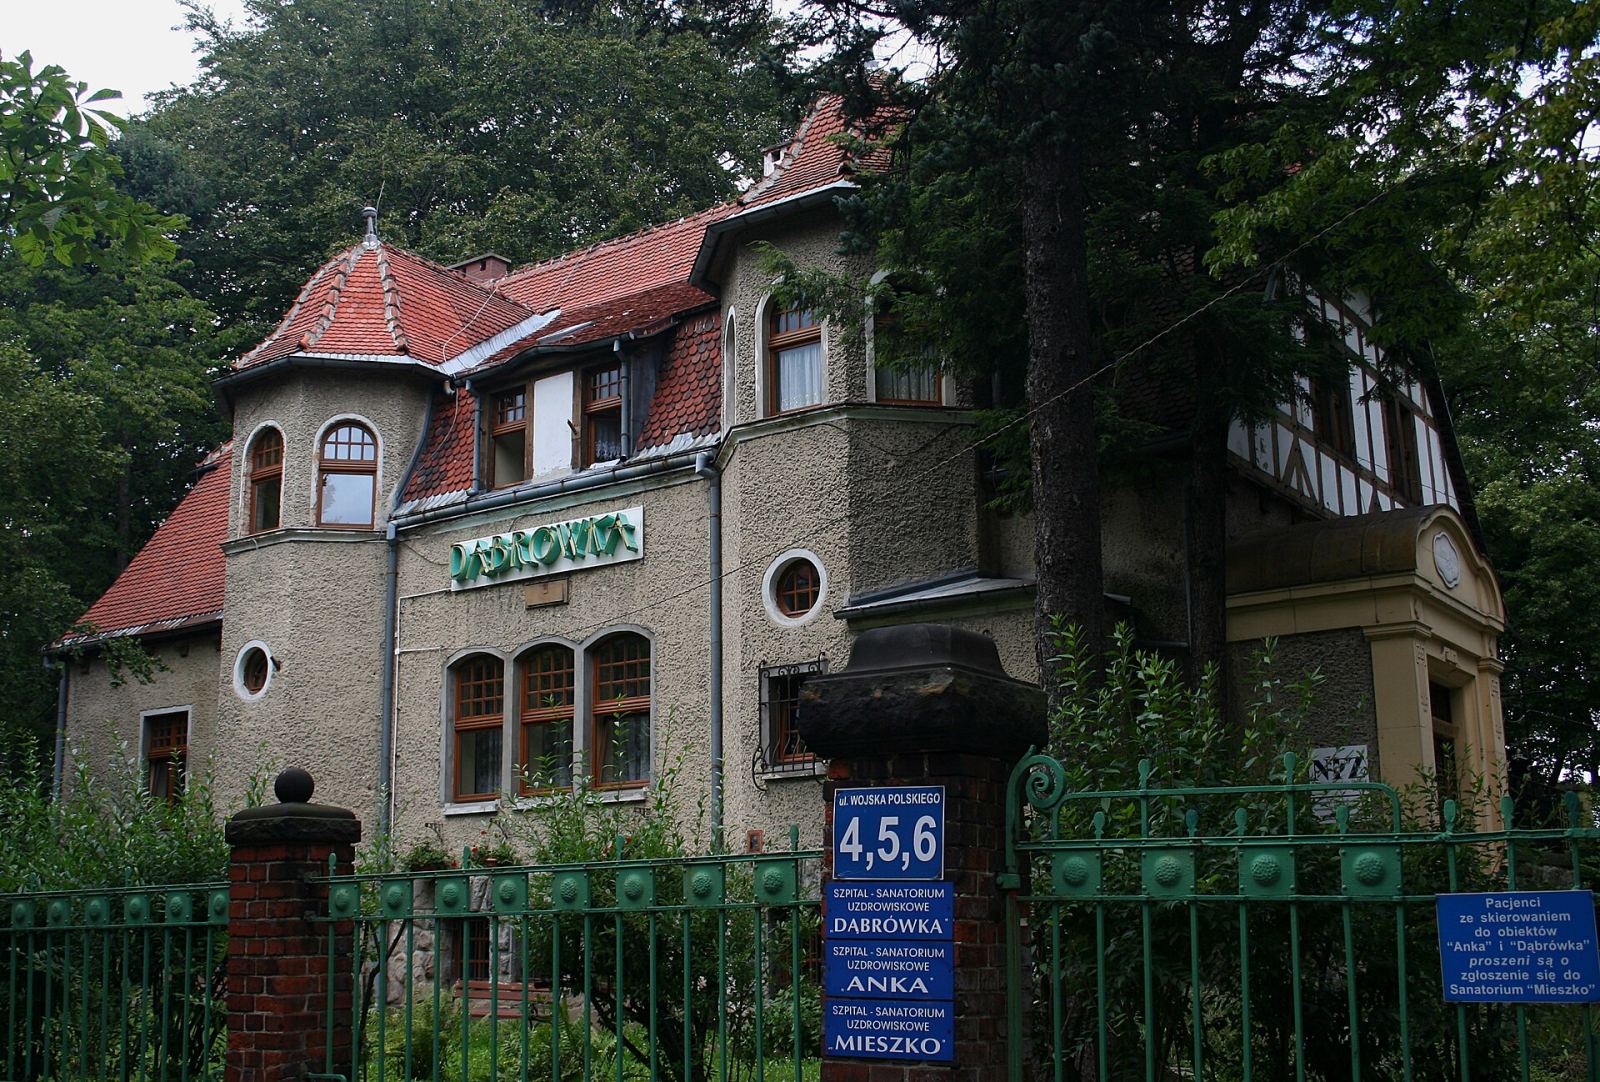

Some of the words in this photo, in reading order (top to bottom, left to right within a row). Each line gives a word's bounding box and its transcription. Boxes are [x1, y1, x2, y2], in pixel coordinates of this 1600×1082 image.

[839, 797, 848, 806] ul.
[851, 795, 886, 805] WOJSKA
[888, 793, 940, 805] POLSKIEGO
[839, 815, 937, 871] 4,5,6
[833, 888, 868, 898] SZPITAL
[876, 888, 945, 899] SANATORIUM
[847, 902, 930, 912] UZDROWISKOWE
[1485, 897, 1541, 910] Pacjenci
[1459, 914, 1474, 923] ze
[1480, 911, 1571, 923] skierowaniem
[1474, 926, 1491, 937] do
[1498, 925, 1557, 937] obiektów
[1499, 941, 1503, 951] i
[833, 947, 868, 957] SZPITAL
[875, 948, 945, 958] SANATORIUM
[847, 960, 930, 972] UZDROWISKOWE
[1469, 955, 1530, 968] proszeni
[1537, 956, 1553, 968] są
[1560, 956, 1569, 965] o
[1460, 970, 1529, 982] zgłoszenie
[1536, 970, 1556, 982] się
[1563, 969, 1581, 981] do
[1450, 984, 1524, 995] Sanatorium
[832, 1006, 868, 1016] SZPITAL
[875, 1007, 945, 1018] SANATORIUM
[846, 1019, 930, 1032] UZDROWISKOWE
